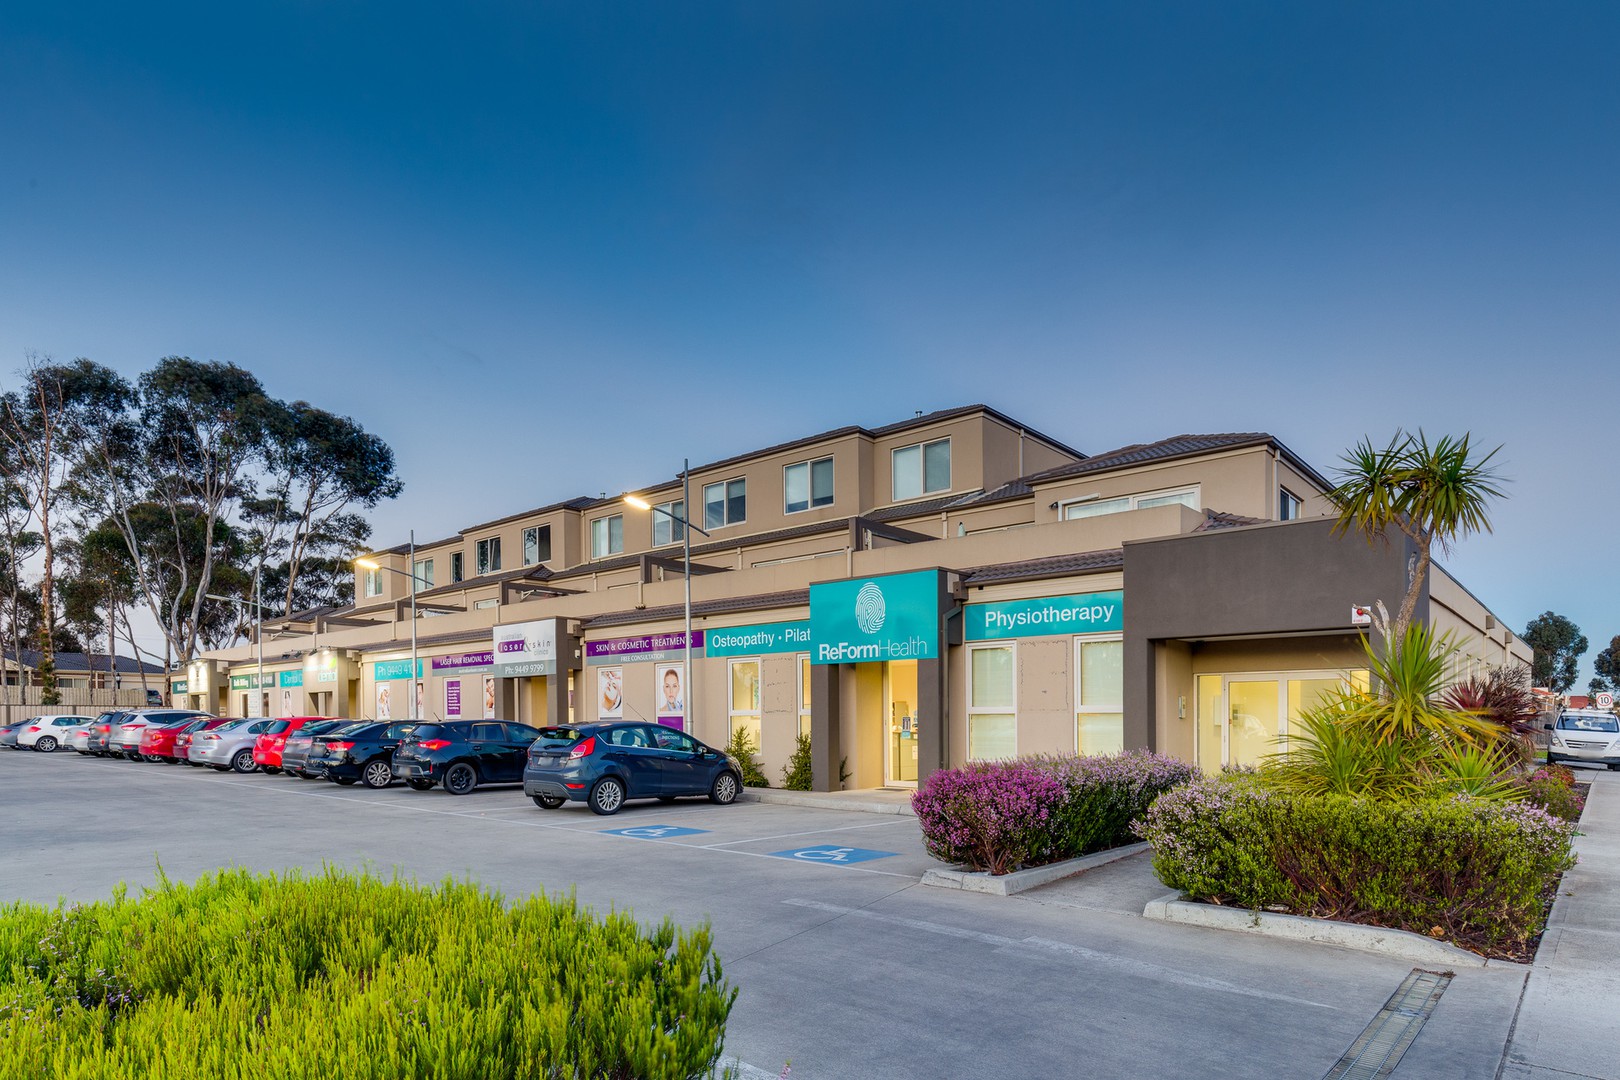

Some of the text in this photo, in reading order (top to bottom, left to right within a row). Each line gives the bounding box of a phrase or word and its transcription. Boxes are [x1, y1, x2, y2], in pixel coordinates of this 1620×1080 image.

[985, 603, 1115, 630] Physiotherapy
[532, 640, 551, 648] skin
[712, 631, 775, 649] Osteopathy
[596, 644, 609, 652] SKIN
[610, 643, 616, 651] &
[617, 640, 649, 650] COSMETIC
[463, 655, 482, 664] REMOVAL
[631, 653, 665, 662] CONSULTATION
[378, 666, 386, 676] Ph
[514, 664, 529, 674] 9449
[530, 663, 544, 673] 9799
[1600, 696, 1609, 704] 10
